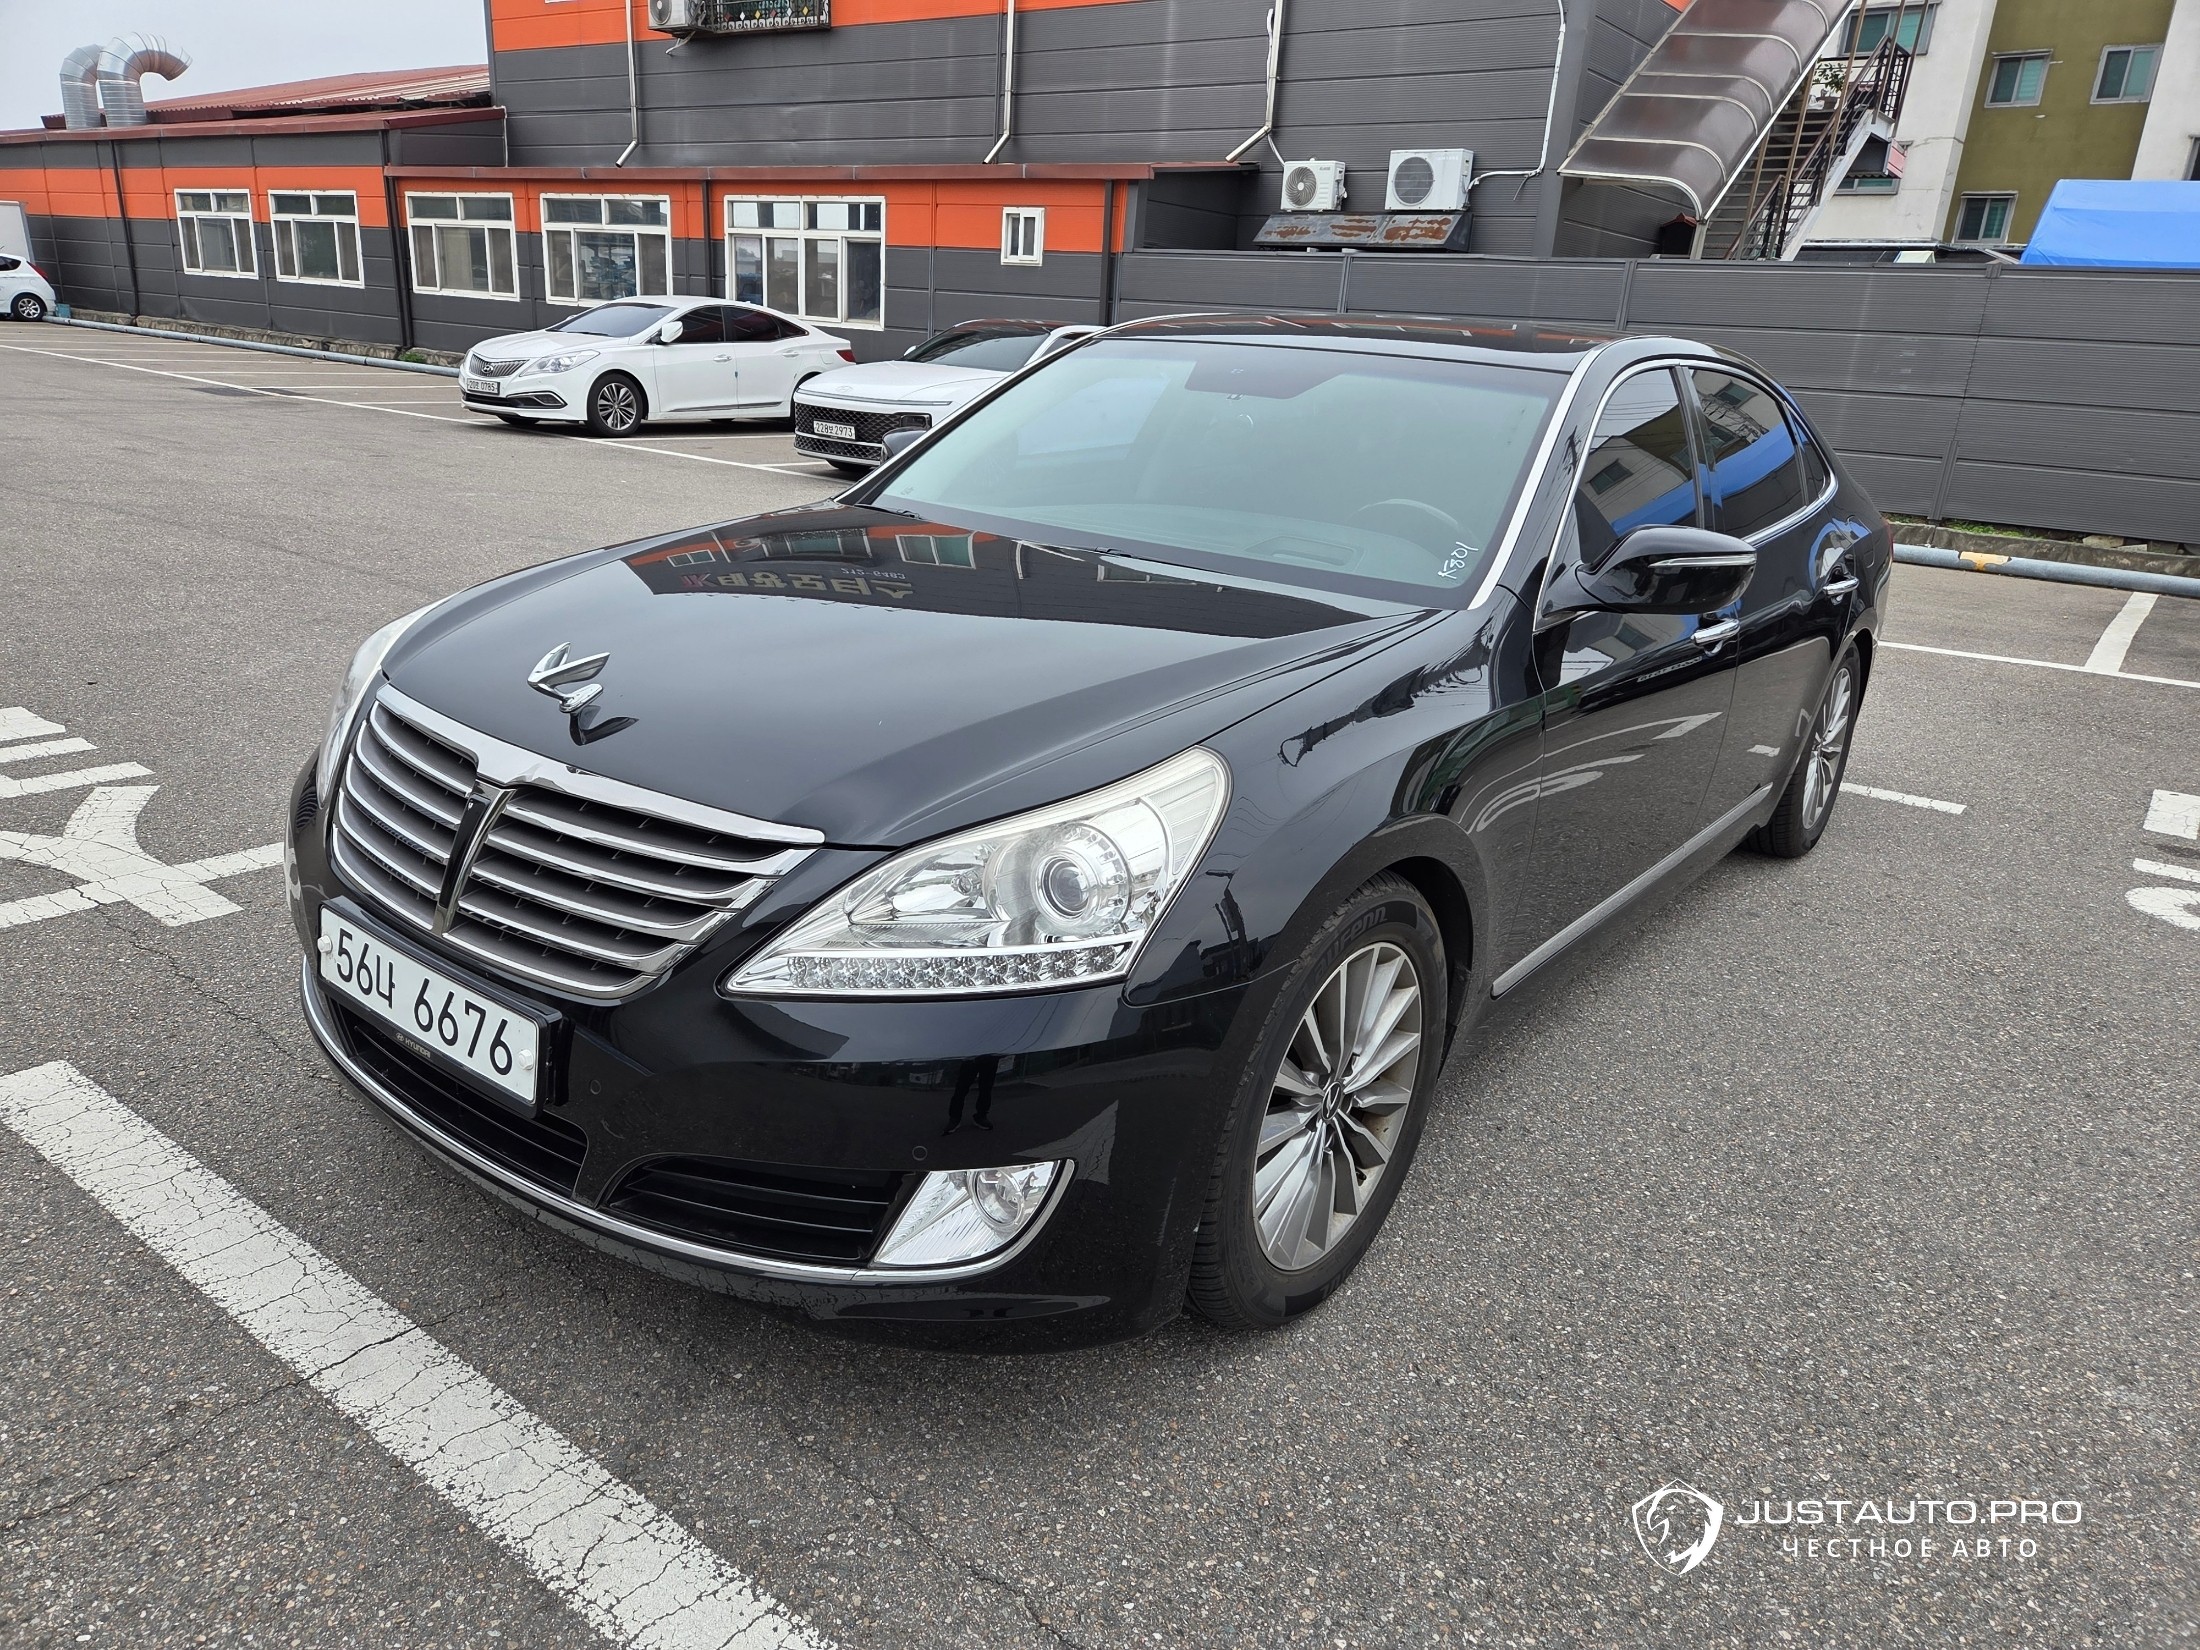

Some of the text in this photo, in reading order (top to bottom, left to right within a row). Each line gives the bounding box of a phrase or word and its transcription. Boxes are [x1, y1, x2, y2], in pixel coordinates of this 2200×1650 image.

[336, 928, 513, 1075] 56나 6676
[405, 1037, 431, 1058] HYUNDAI
